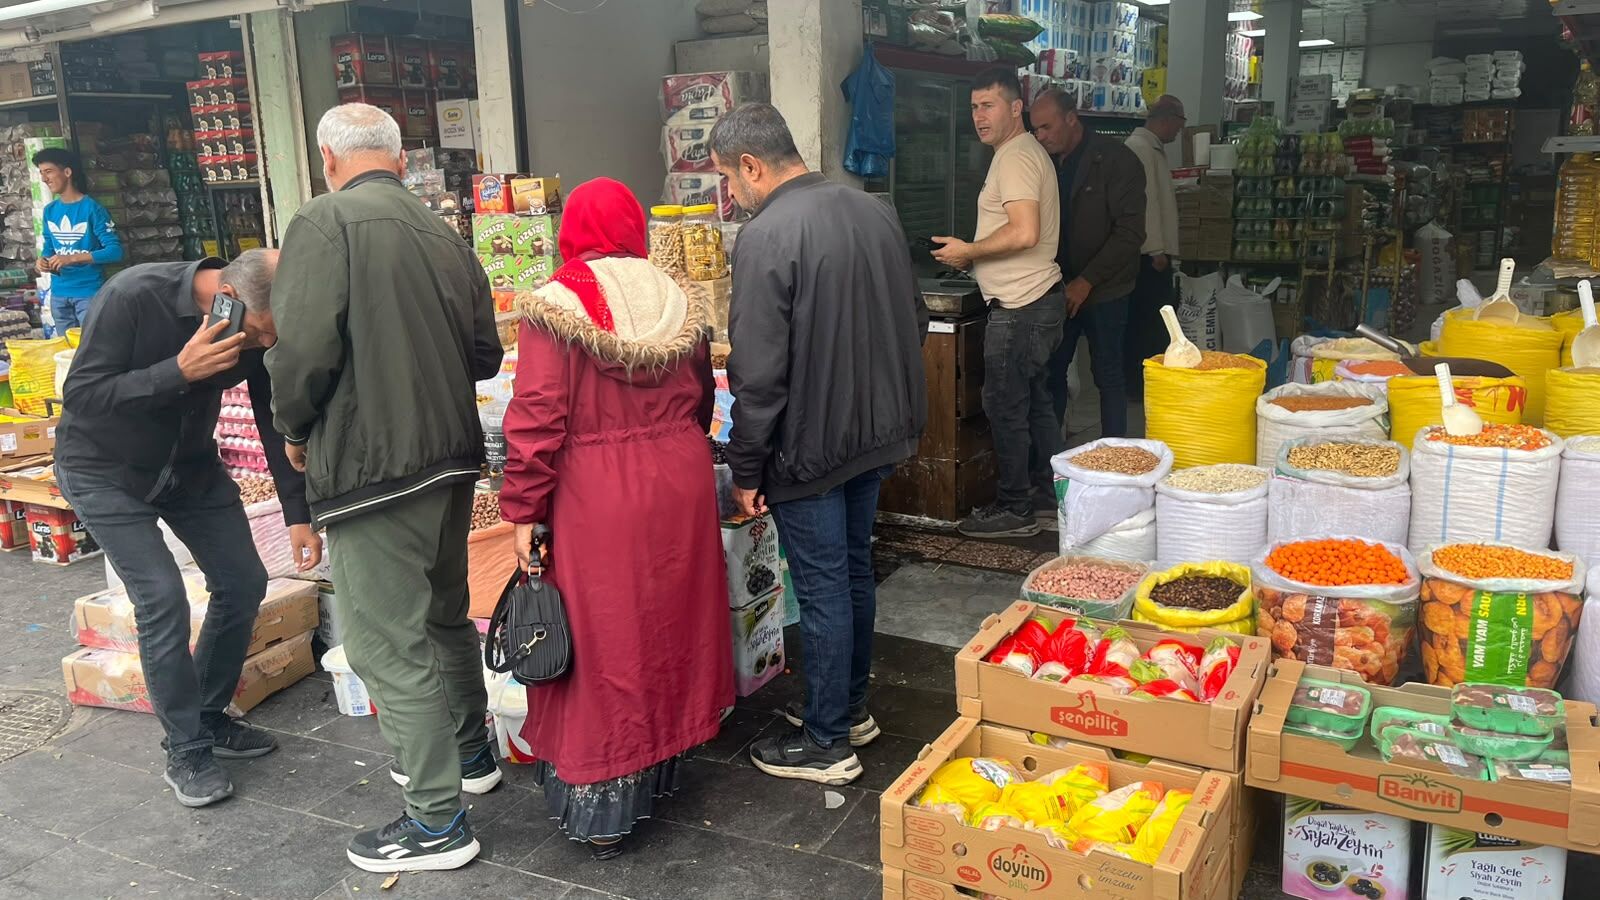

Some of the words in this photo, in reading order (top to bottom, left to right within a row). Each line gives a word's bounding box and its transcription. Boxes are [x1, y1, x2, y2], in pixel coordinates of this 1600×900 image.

[367, 53, 386, 62] Loras
[408, 107, 426, 116] Loras
[33, 523, 51, 534] Loras
[1515, 592, 1527, 616] ORN
[1475, 619, 1489, 643] YAM
[1472, 644, 1487, 668] YAM
[1059, 709, 1118, 735] şenpiliç
[1384, 780, 1456, 808] Banvit
[993, 856, 1046, 883] doyum
[1470, 870, 1493, 882] Siyah
[1495, 875, 1522, 888] Zeytin
[1471, 860, 1497, 874] Yağlı
[1500, 866, 1522, 878] Sele
[1008, 878, 1029, 892] piliç
